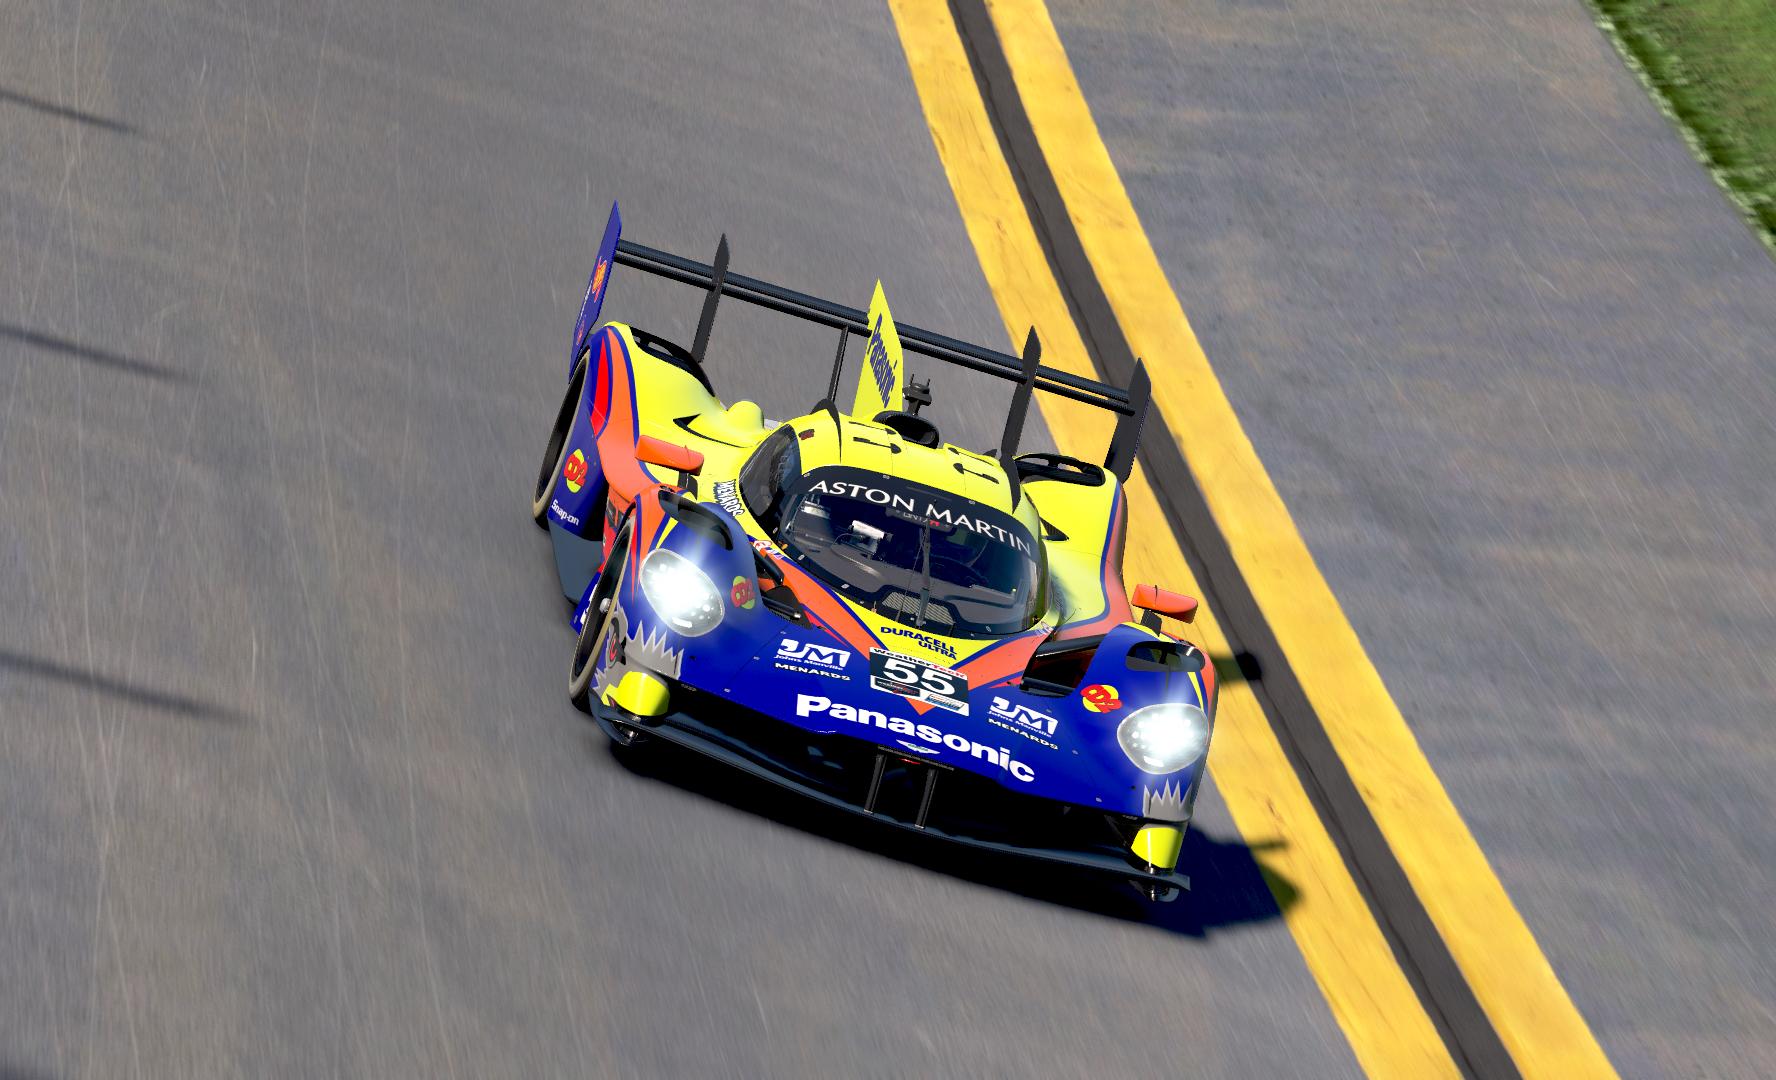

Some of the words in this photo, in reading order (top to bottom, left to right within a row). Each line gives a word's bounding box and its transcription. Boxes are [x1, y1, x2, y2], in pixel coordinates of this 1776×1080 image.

[808, 479, 914, 512] ASTON
[925, 503, 1031, 557] MARTIN
[777, 638, 851, 668] JM
[880, 626, 958, 655] DURACELL
[918, 640, 957, 660] ULTRA
[775, 662, 851, 681] MENARDS
[803, 659, 844, 671] Manville
[882, 657, 955, 695] 55
[989, 696, 1059, 735] JM
[796, 693, 1036, 783] Panasonic
[987, 718, 1059, 750] MENARDS
